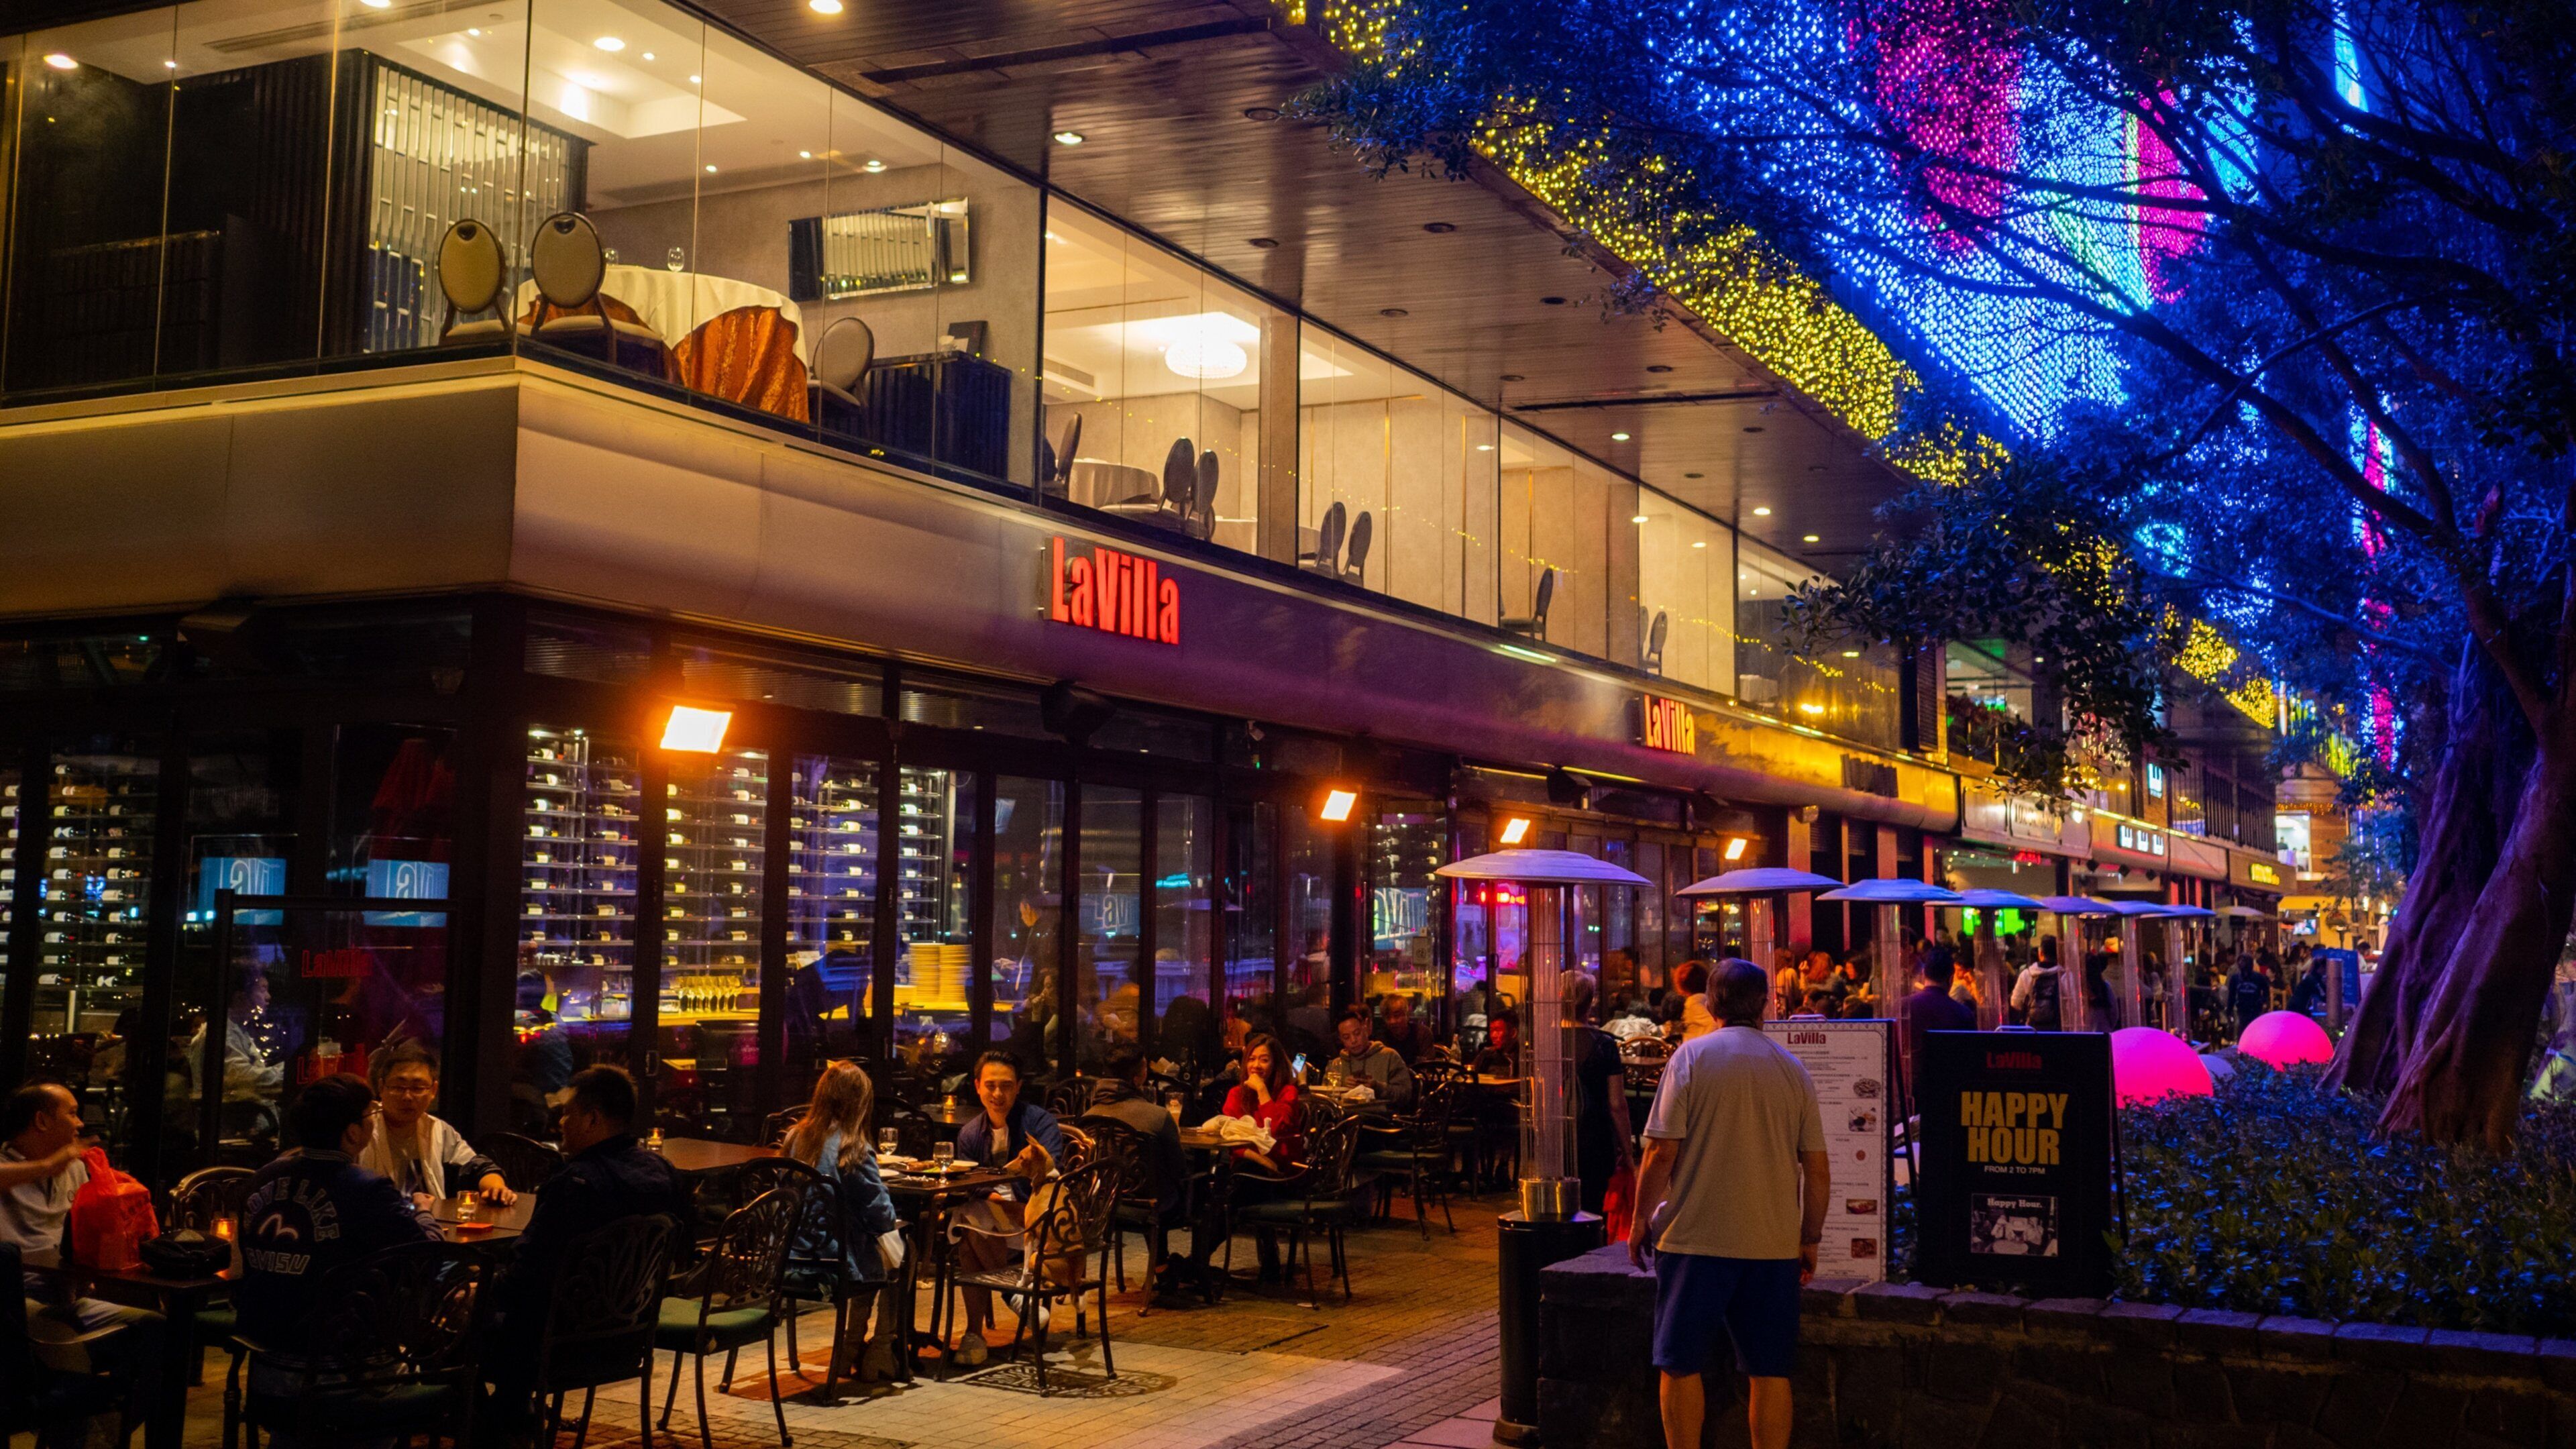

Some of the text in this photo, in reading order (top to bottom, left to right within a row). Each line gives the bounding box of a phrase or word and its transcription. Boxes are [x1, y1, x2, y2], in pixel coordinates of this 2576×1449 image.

[1051, 535, 1180, 645] LaVilla
[1644, 694, 1696, 755] LaVilla
[1787, 1032, 1826, 1044] LaVilla
[1986, 1051, 2043, 1069] LaVilla
[1960, 1091, 2069, 1130] HAPPY
[1967, 1126, 2061, 1165] HOUR
[1984, 1165, 2008, 1173] FROM
[2029, 1167, 2045, 1175] 7PM
[292, 1178, 341, 1242] LIKE
[1987, 1197, 2043, 1209] Happy Hour.
